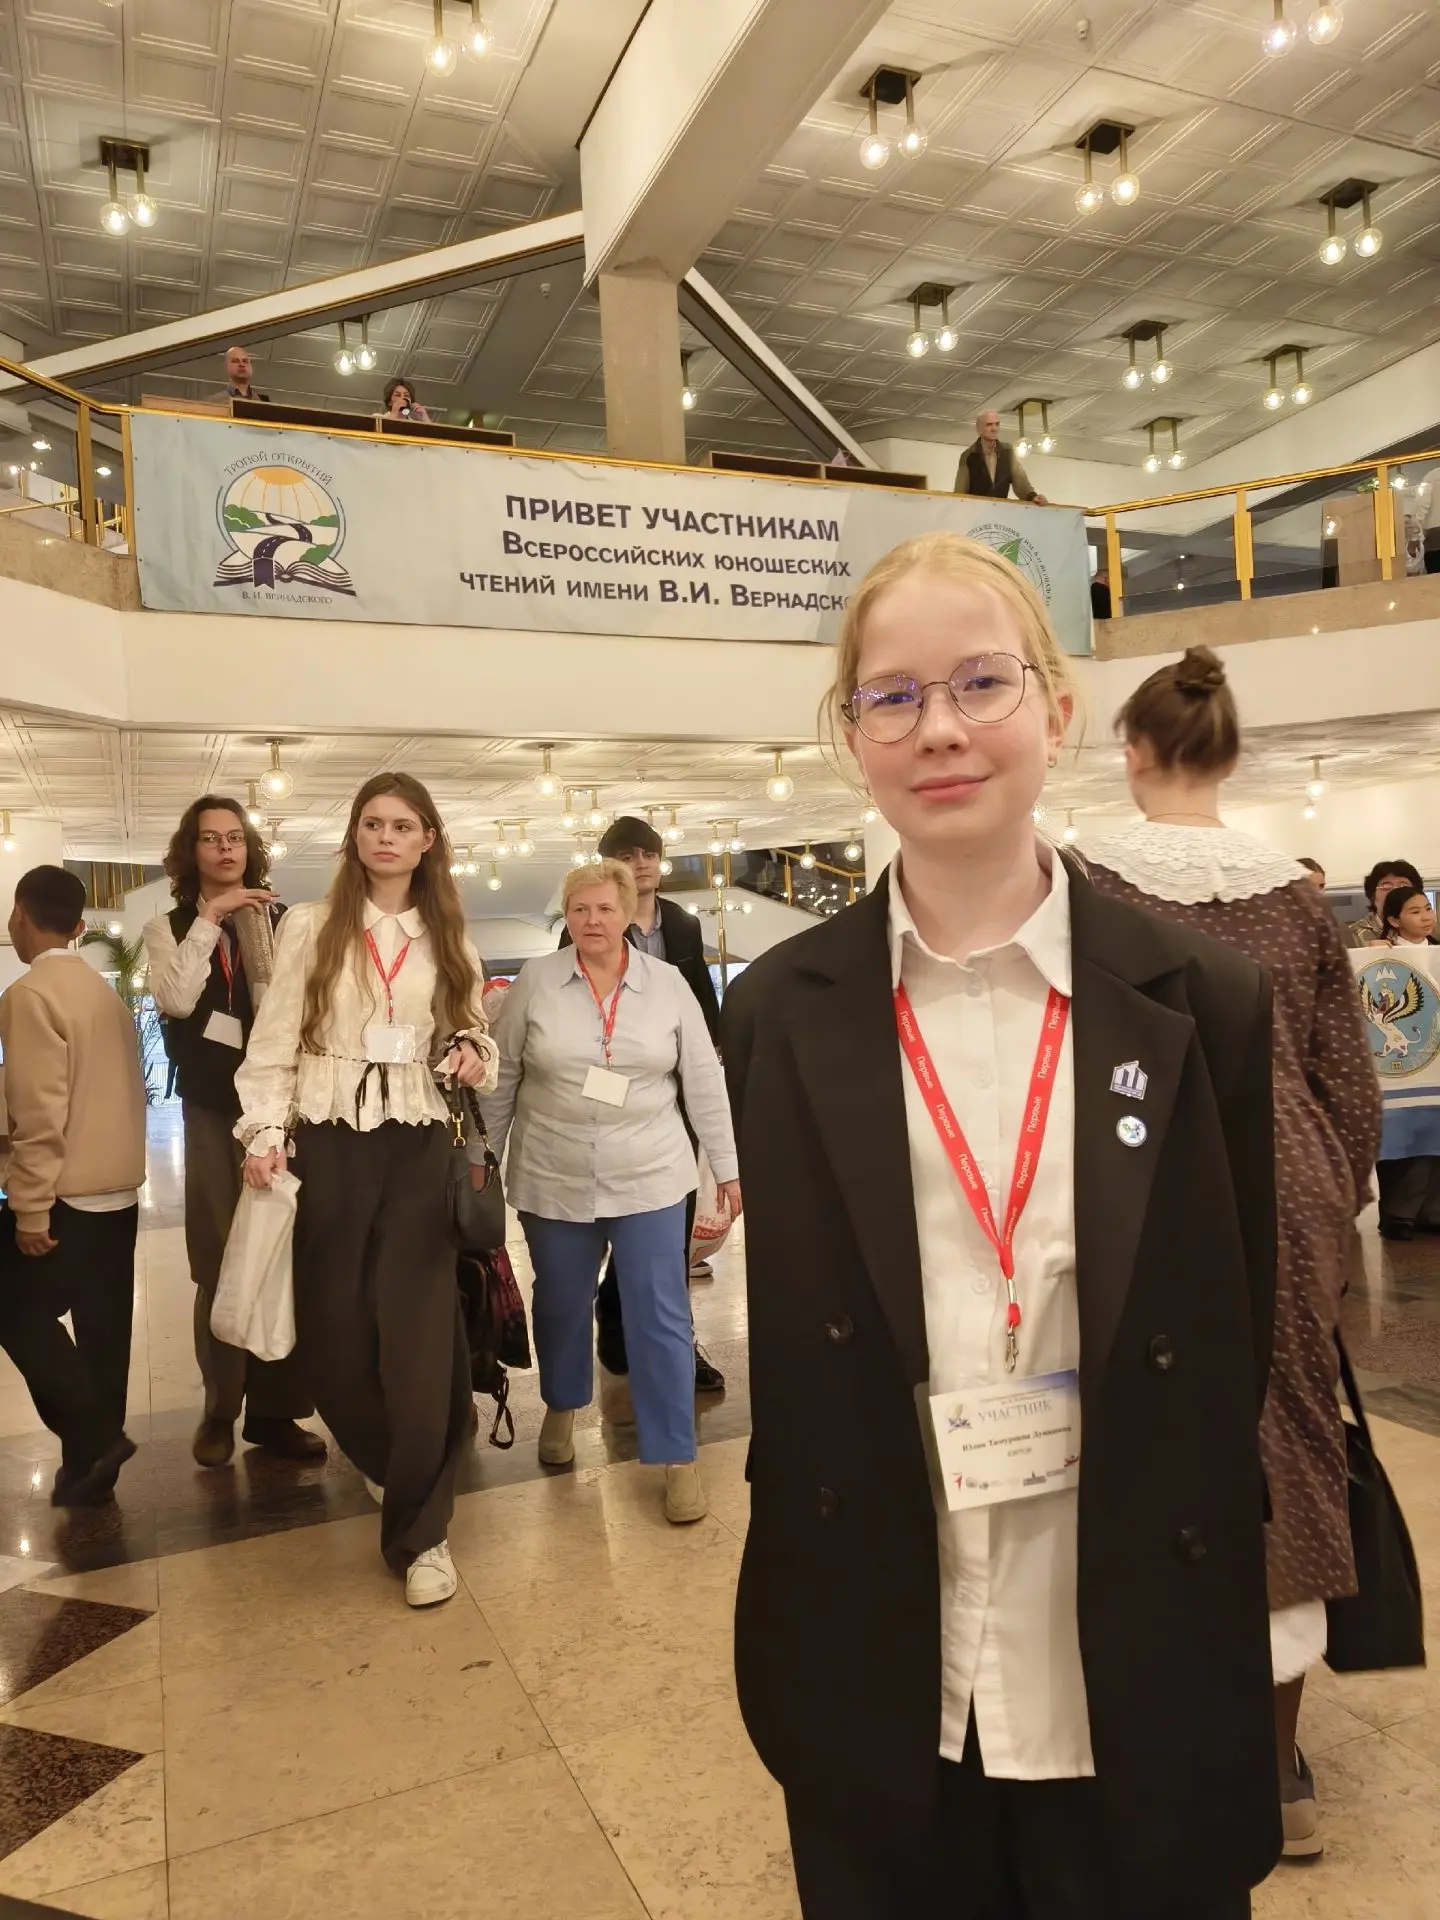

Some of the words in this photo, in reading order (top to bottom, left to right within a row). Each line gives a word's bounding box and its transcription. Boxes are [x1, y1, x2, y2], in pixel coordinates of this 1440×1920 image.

[223, 450, 268, 477] ТРОПОЙ
[505, 494, 632, 529] ПРИВЕТ
[641, 506, 840, 542] УЧАСТНИКАМ
[658, 579, 720, 605] В.И.
[900, 1010, 916, 1043] Первые
[917, 1055, 933, 1089] Первые
[1037, 1045, 1053, 1079] Первые
[936, 1103, 955, 1139] Первые
[1026, 1096, 1042, 1133] Первые
[959, 1153, 978, 1190] Первые
[1016, 1151, 1032, 1189] Первые
[978, 1400, 1053, 1422] УЧАСТНИК
